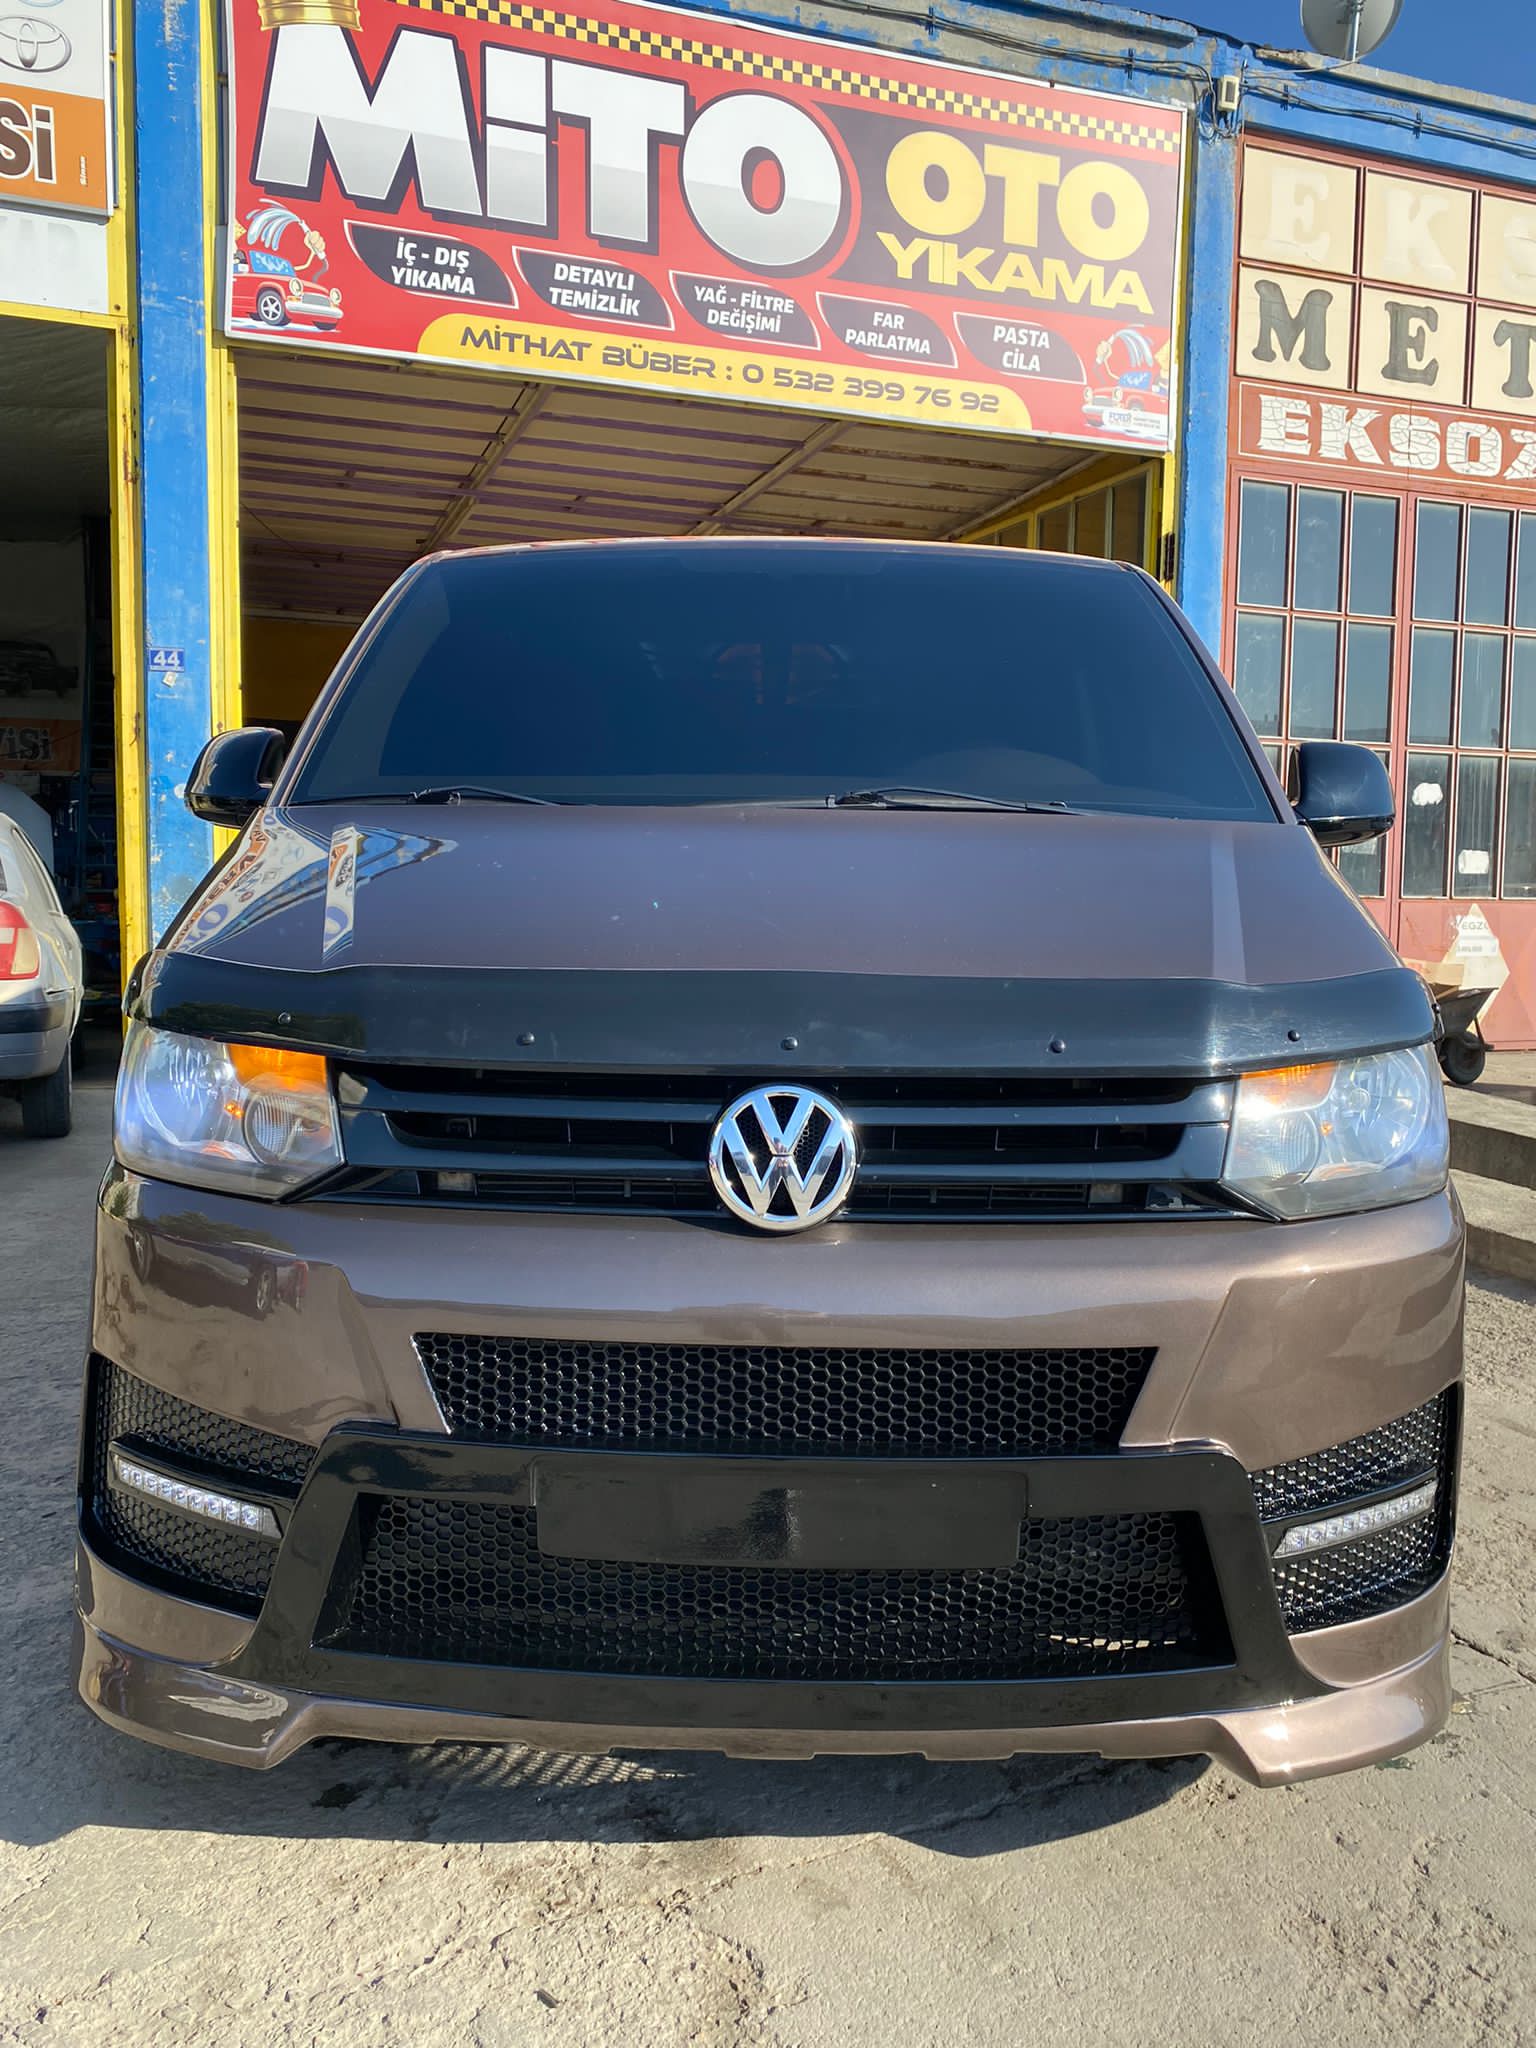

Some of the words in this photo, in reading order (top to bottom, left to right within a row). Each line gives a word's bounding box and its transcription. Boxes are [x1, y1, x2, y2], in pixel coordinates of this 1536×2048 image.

[885, 130, 1150, 262] OTO
[396, 237, 417, 266] İÇ
[434, 247, 470, 273] DIŞ
[391, 266, 475, 295] YIKAMA
[554, 263, 634, 291] DETAYLI
[876, 231, 1154, 315] YIKAMA
[549, 287, 640, 316] TEMİZLİK
[695, 285, 727, 304] YAĞ
[740, 291, 794, 313] FİLTRE
[873, 311, 905, 329] FAR
[845, 329, 931, 354] PARLATMA
[993, 325, 1050, 349] PASTA
[1002, 348, 1040, 372] CİLA
[602, 344, 716, 378] BÜBER
[773, 367, 834, 393] 532
[843, 376, 905, 401] 399
[913, 386, 952, 408] 76
[960, 391, 999, 413] 92
[153, 649, 181, 667] 44
